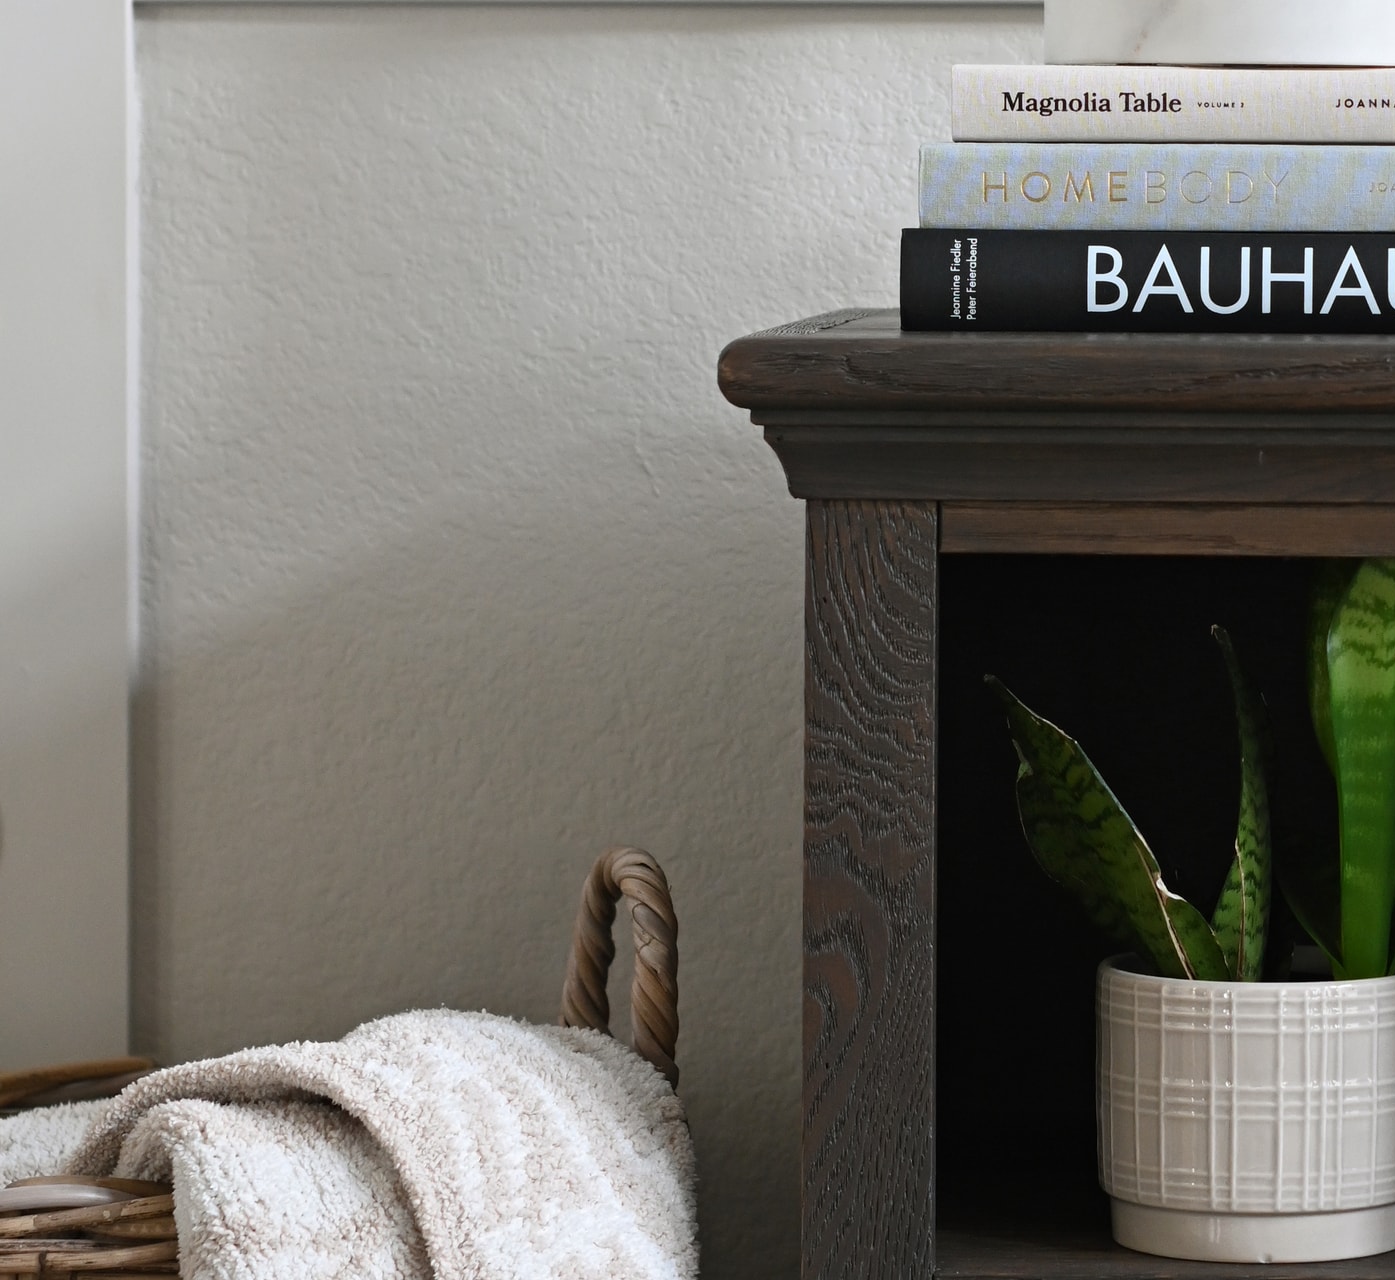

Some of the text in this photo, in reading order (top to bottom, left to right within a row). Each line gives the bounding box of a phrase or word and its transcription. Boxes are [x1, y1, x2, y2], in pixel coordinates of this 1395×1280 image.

[1001, 91, 1111, 117] Magnolia
[1118, 91, 1182, 113] Table
[982, 170, 1289, 204] HOMEBODY
[950, 239, 962, 320] Jeannine Fiedler
[966, 237, 978, 320] Peter Feierabend
